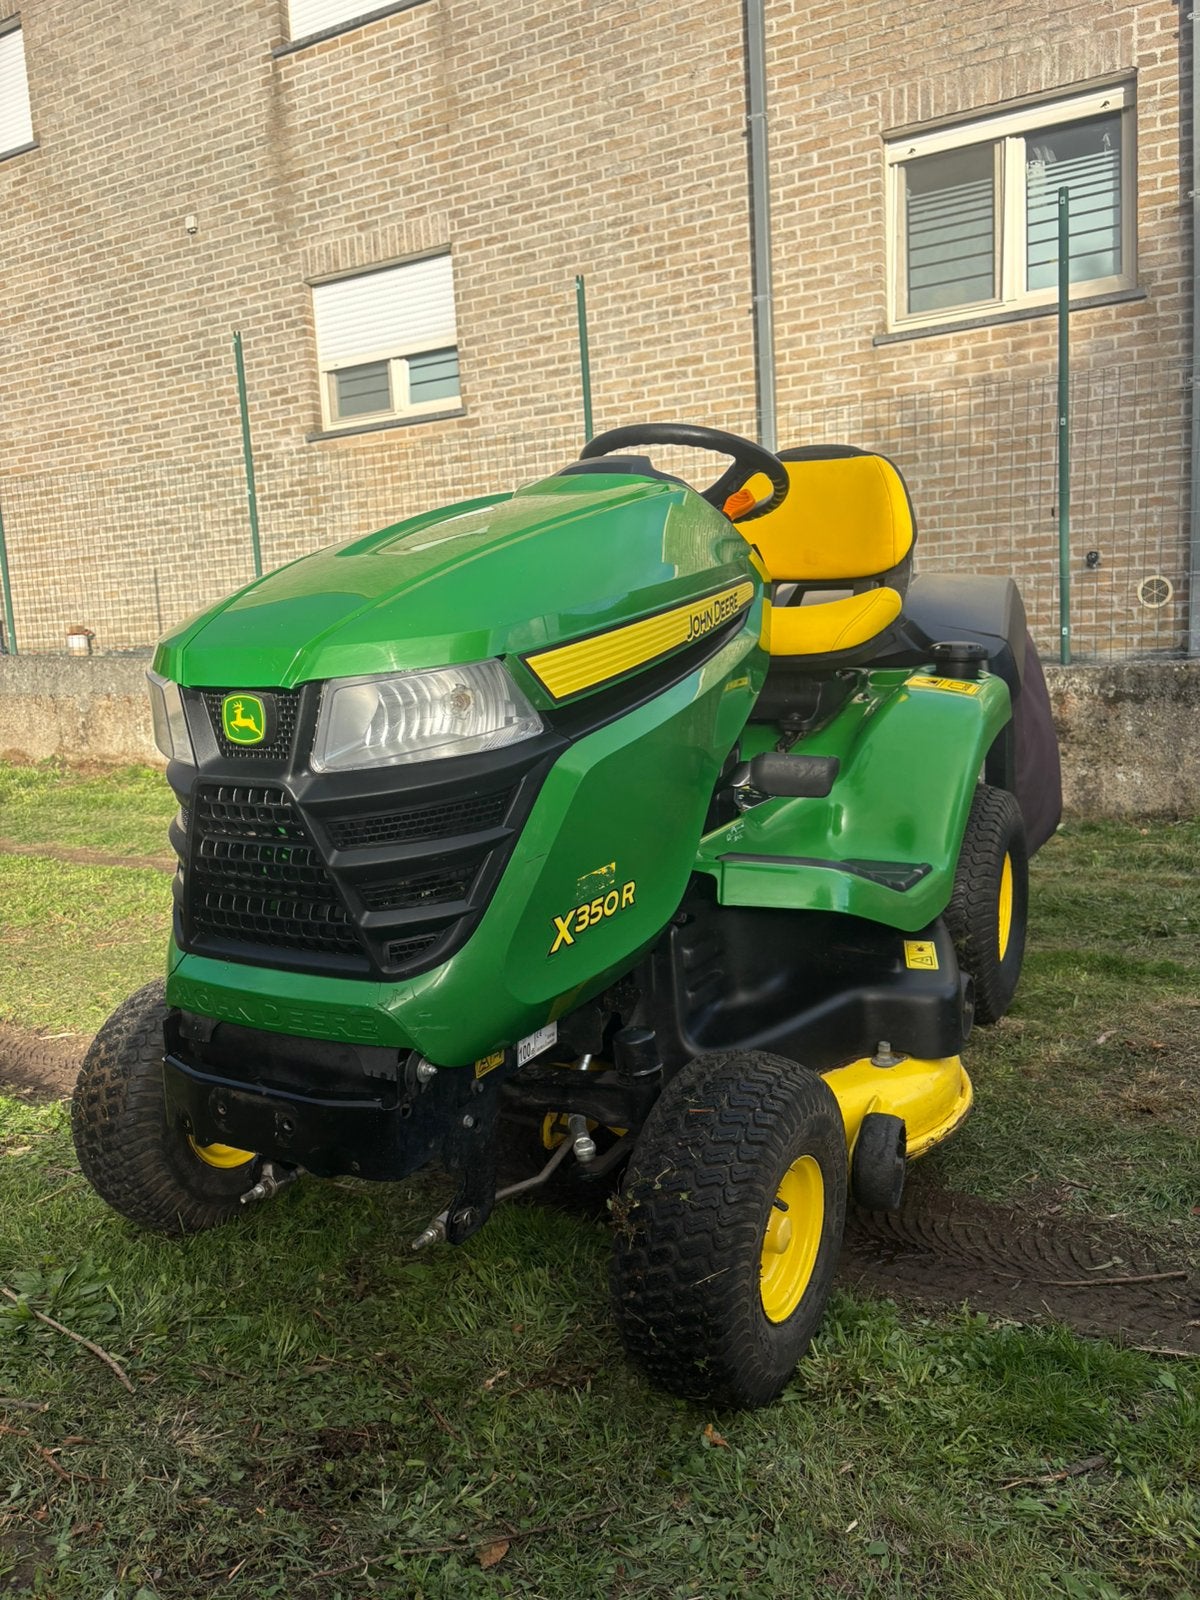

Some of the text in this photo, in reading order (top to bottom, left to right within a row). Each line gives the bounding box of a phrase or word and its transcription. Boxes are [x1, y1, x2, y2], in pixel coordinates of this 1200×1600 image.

[686, 591, 739, 640] JOHN DEERE
[548, 880, 635, 956] X350R
[262, 1001, 379, 1040] DEERE
[519, 1042, 531, 1063] 100
